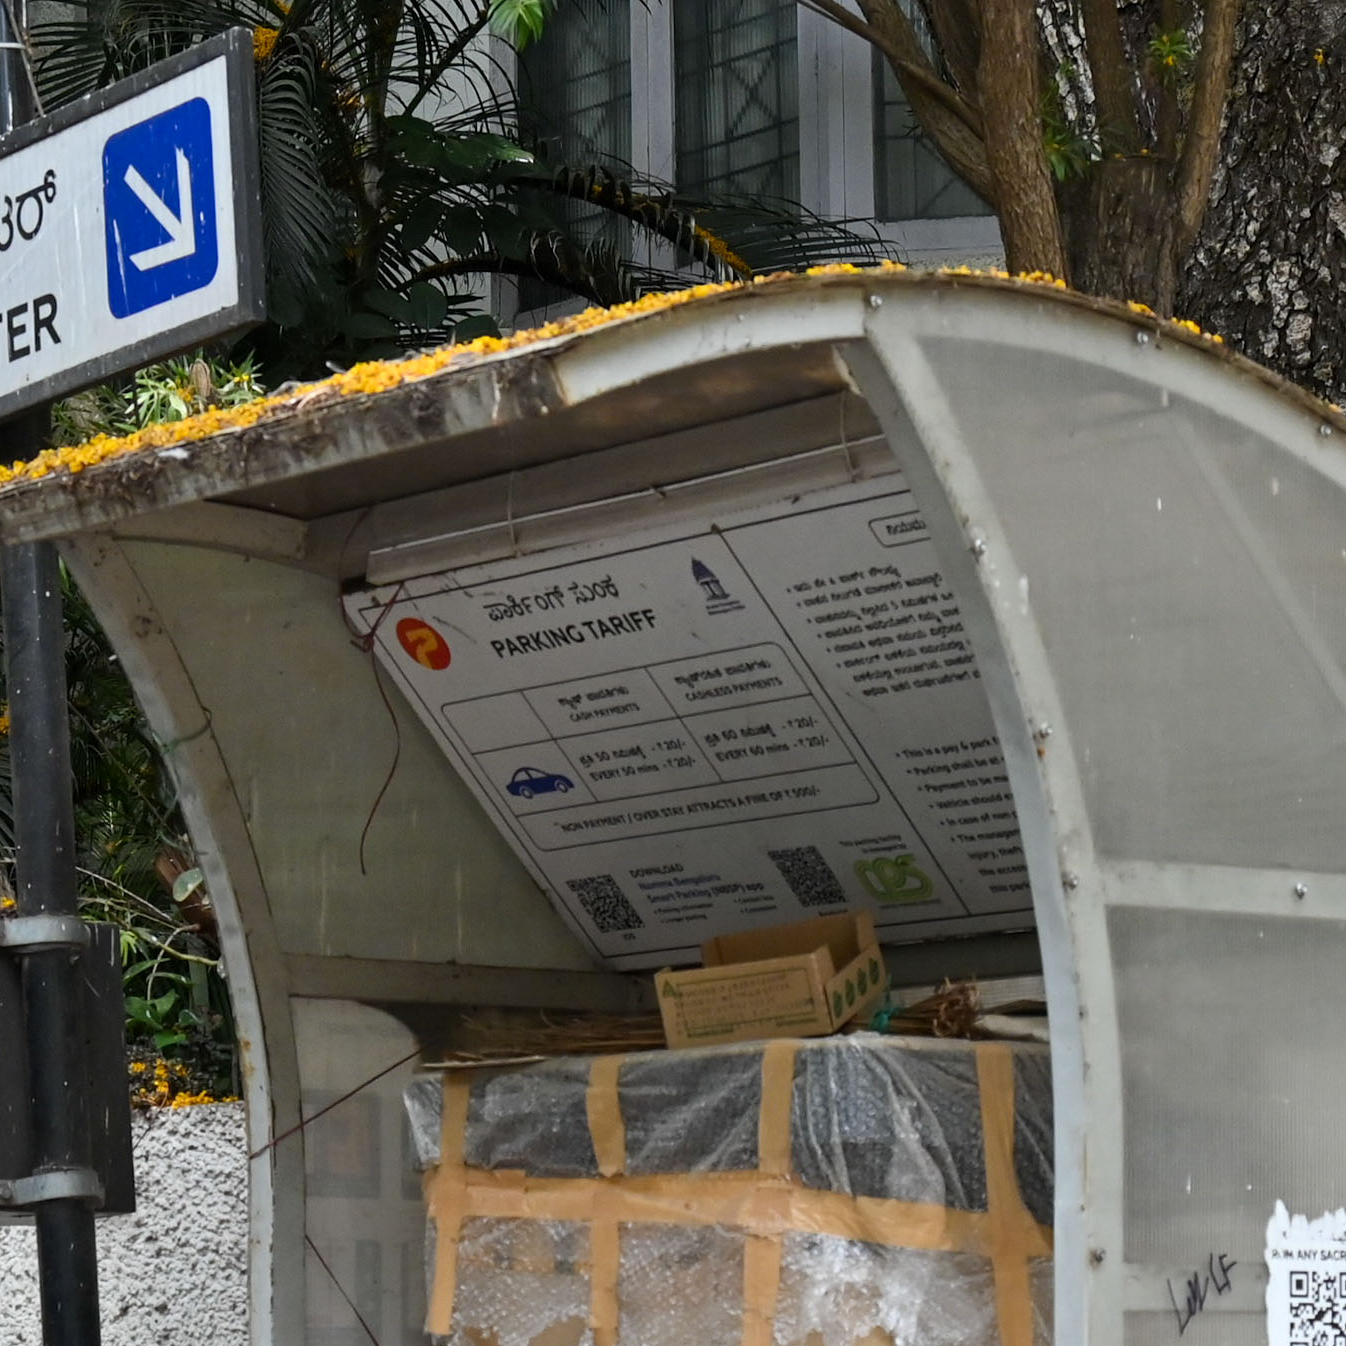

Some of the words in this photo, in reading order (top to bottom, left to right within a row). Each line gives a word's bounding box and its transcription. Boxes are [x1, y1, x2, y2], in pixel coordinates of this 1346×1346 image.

[483, 587, 565, 622] ಪಾರ್ಕಿಂಗ್
[490, 625, 585, 658] PARKING
[582, 608, 657, 640] TARIFF
[685, 686, 733, 702] CASHLESS
[732, 676, 783, 692] PAYMENTS
[569, 711, 594, 722] CASH
[593, 702, 641, 719] PAYMENTS
[715, 748, 749, 762] EVERY
[765, 743, 790, 753] mins
[941, 745, 960, 755] pay
[970, 738, 991, 751] park
[589, 769, 621, 782] EVERY
[637, 764, 660, 773] mins
[913, 766, 952, 775] Parking
[924, 780, 966, 793] Payment
[936, 798, 970, 809] Vehicle
[970, 792, 1003, 805] should
[583, 814, 626, 829] PAYMENT
[633, 809, 661, 821] OVER
[660, 806, 685, 818] STAY
[686, 798, 736, 813] ATTRACTS
[745, 792, 769, 804] FINE
[768, 791, 783, 801] OF
[957, 816, 980, 825] case
[629, 862, 684, 878] DOWNLOAD
[647, 893, 676, 903] Smart
[675, 889, 711, 900] Parking
[1297, 1249, 1318, 1261] ANY
